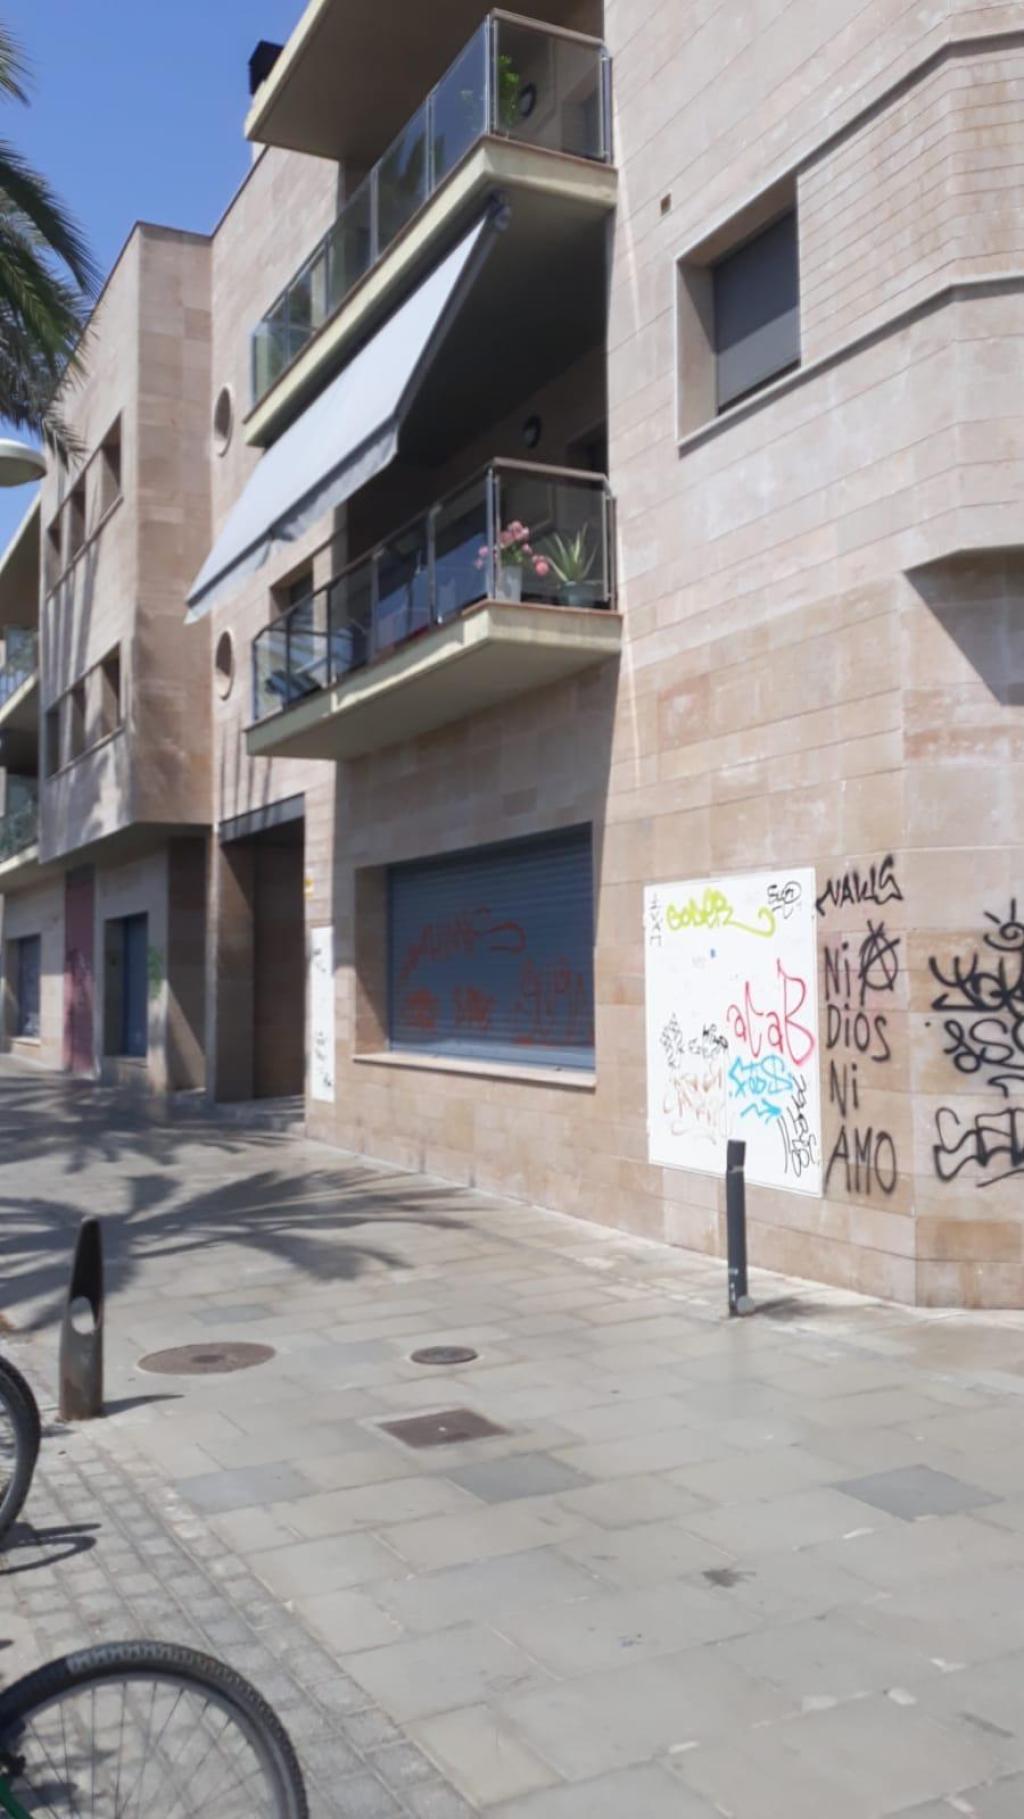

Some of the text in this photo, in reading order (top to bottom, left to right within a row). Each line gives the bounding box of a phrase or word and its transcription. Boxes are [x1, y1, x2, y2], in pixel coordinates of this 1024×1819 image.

[824, 942, 850, 1001] Ni
[829, 1059, 859, 1118] Ni
[823, 1124, 897, 1196] AMO
